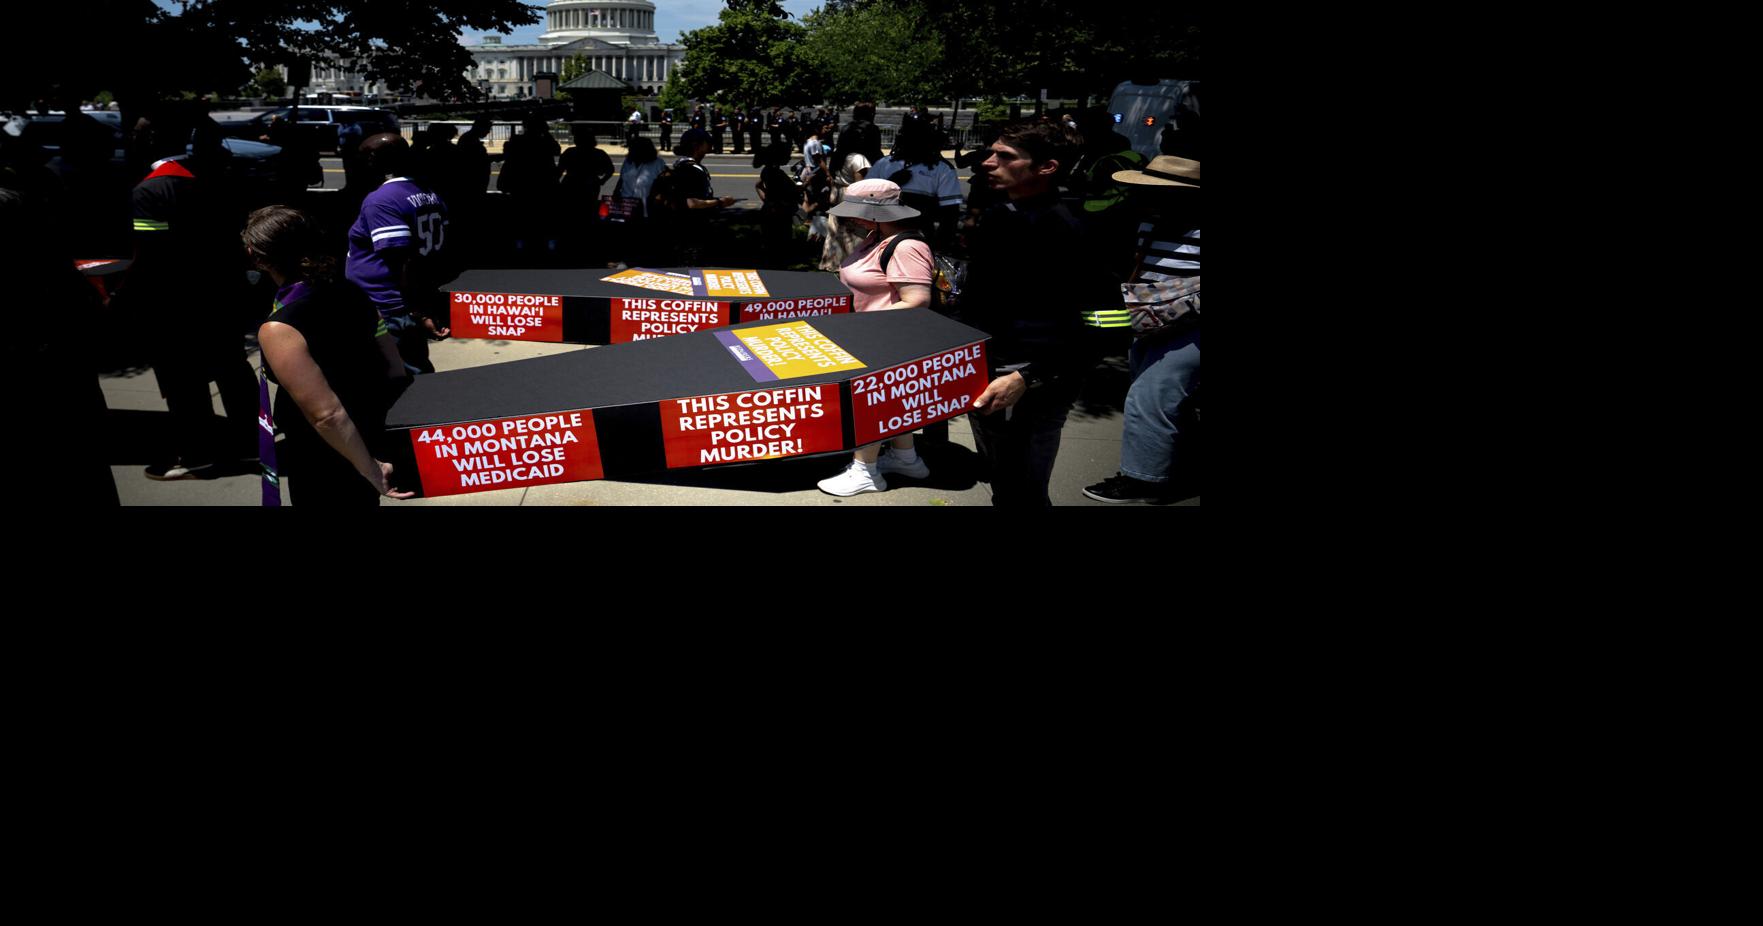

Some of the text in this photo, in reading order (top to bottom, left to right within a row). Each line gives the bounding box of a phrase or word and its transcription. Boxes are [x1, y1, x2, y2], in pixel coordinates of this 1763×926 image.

[454, 293, 559, 306] 30,000 PEOPLE
[469, 304, 483, 314] IN
[622, 298, 718, 312] THIS COFFIN
[744, 296, 847, 313] 49,000 PEOPLE
[470, 315, 542, 327] WILL LOSE
[622, 310, 718, 324] REPRESENTS
[641, 322, 698, 334] POLICY
[760, 313, 774, 321] IN
[488, 326, 526, 336] SNAP
[742, 336, 788, 367] MURDER!
[765, 336, 806, 361] POLICY
[776, 327, 837, 368] REPRESENTS
[796, 323, 856, 365] THIS COFFIN
[853, 345, 981, 394] 22,000 PEOPLE
[867, 363, 976, 406] IN MONTANA
[677, 386, 822, 414] THIS COFFIN
[902, 389, 943, 411] WILL
[679, 403, 824, 431] REPRESENTS
[879, 394, 970, 434] LOSE SNAP
[417, 413, 583, 444] 44,000 PEOPLE
[711, 423, 797, 445] POLICY
[434, 430, 579, 458] IN MONTANA
[700, 438, 803, 463] MURDER!
[452, 447, 566, 472] WILL LOSE
[460, 463, 564, 487] MEDICAID
